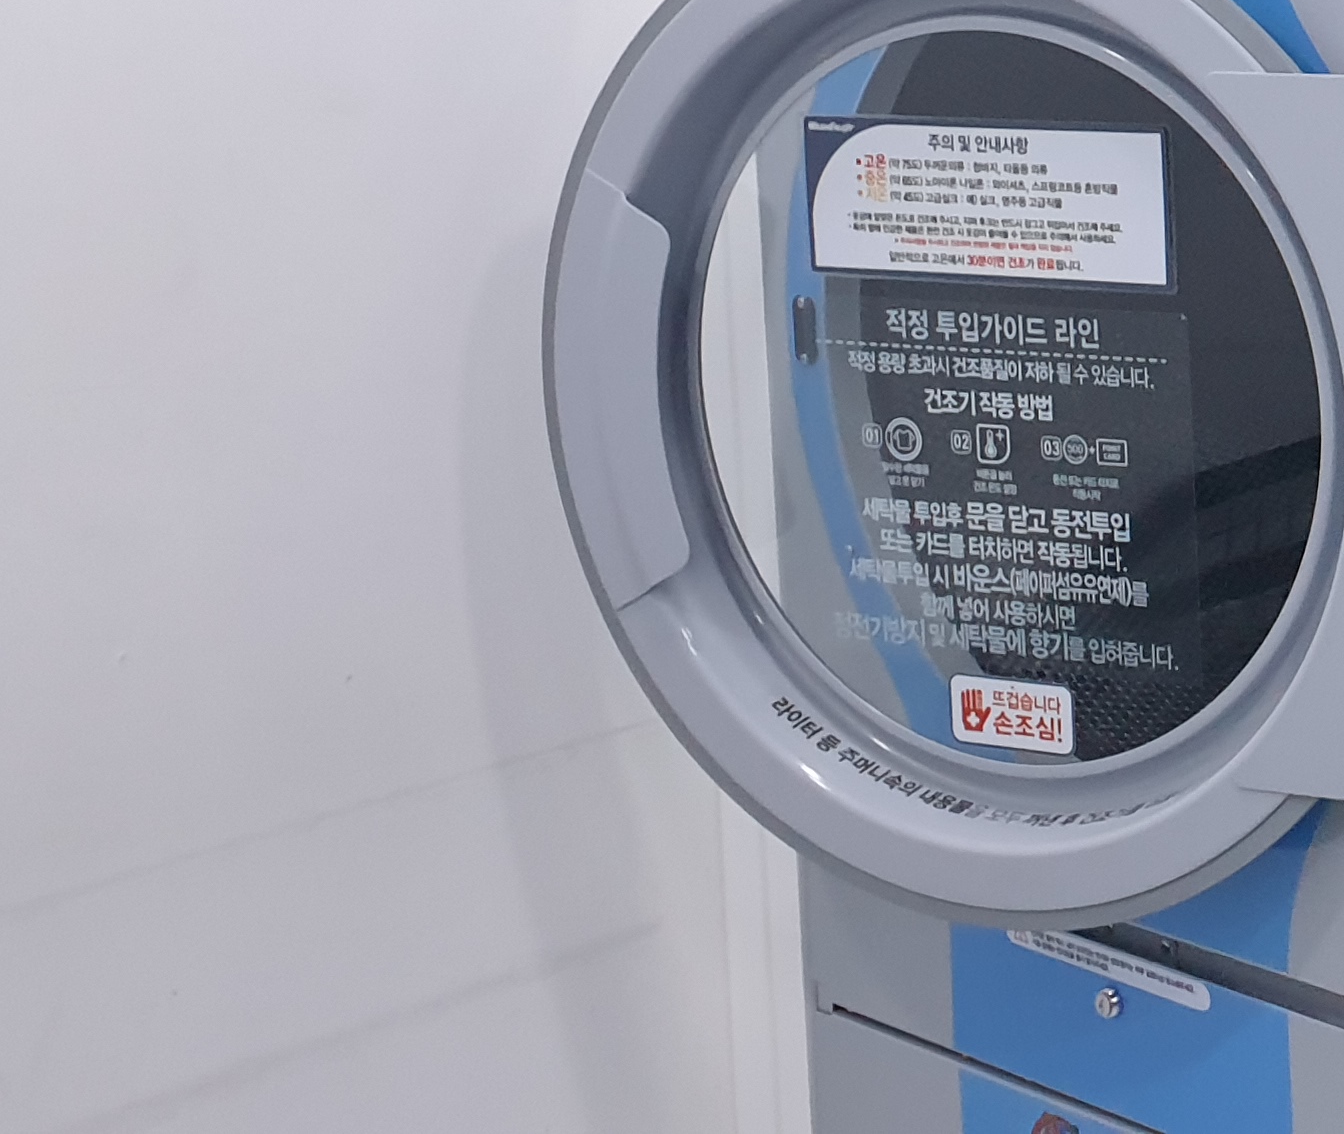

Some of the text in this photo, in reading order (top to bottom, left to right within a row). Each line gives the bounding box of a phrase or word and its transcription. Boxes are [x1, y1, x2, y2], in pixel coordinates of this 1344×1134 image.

[885, 307, 1100, 350] 적정 투입가이드 라인
[923, 387, 1054, 422] 건조기 작동 방법
[863, 497, 1131, 542] 세탁물 투입후 문을 닫고 동전투입
[992, 690, 1062, 714] 뜨겁습니다
[992, 711, 1063, 743] 손조심!
[770, 696, 921, 798] 라이터 등 주머니속의
